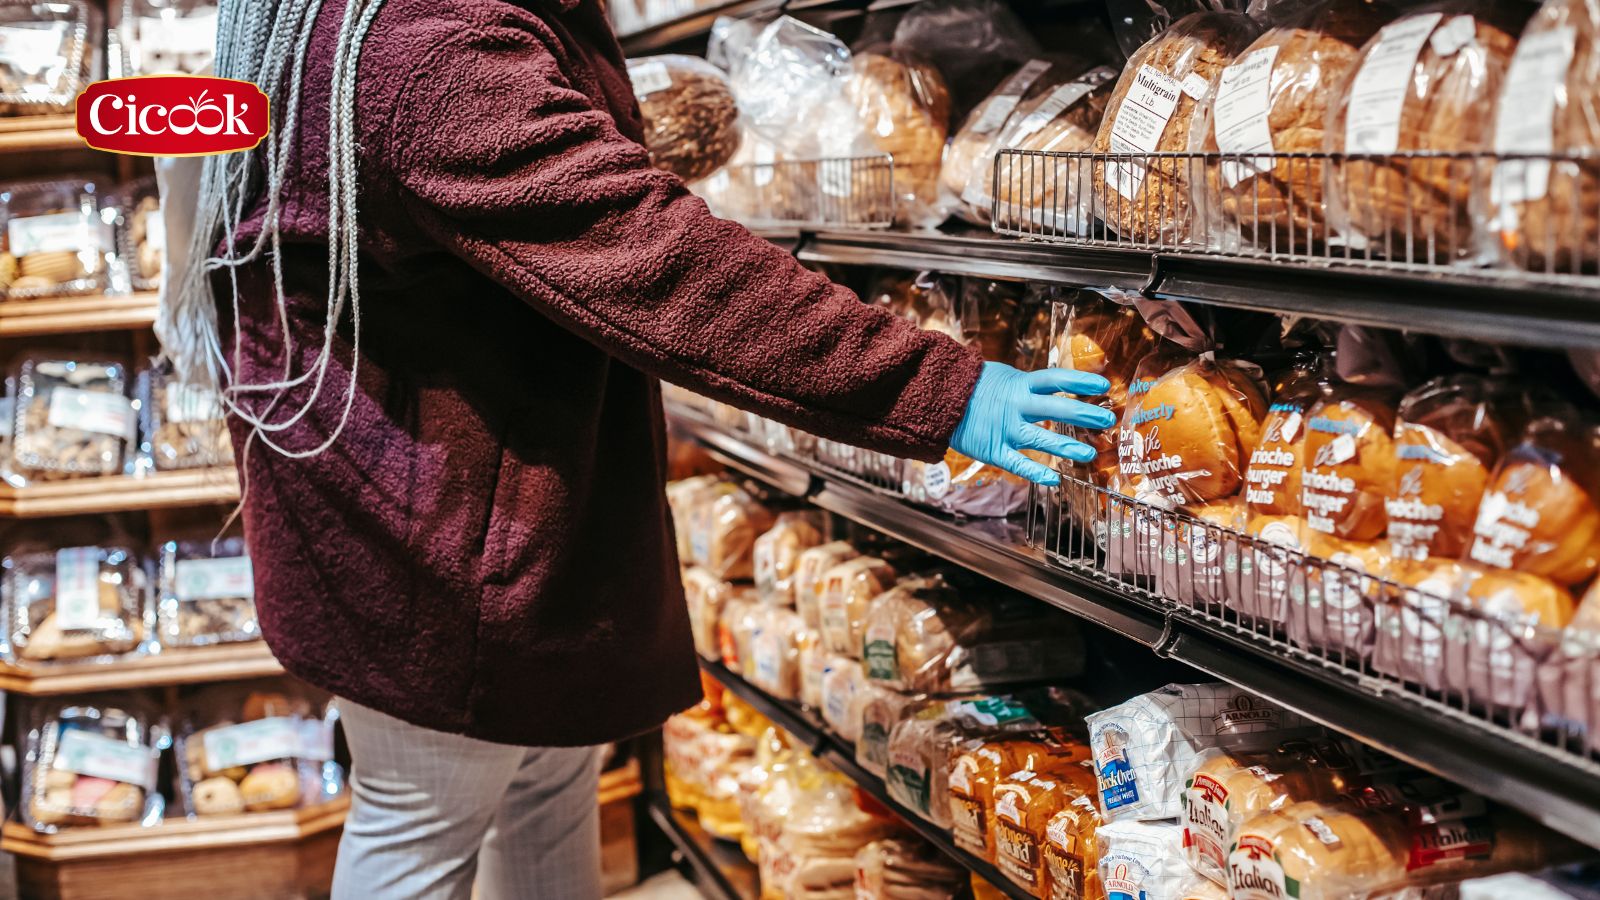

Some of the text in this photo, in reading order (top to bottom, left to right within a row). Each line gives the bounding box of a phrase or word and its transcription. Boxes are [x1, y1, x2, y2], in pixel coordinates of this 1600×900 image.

[1137, 73, 1176, 102] Multigrain
[1154, 69, 1176, 87] NATURAL
[1145, 96, 1154, 107] Lb
[1131, 402, 1176, 425] akerly
[1145, 425, 1161, 455] the
[1142, 453, 1183, 475] rioche
[1148, 474, 1180, 494] urge
[1225, 711, 1271, 721] ARNOLD
[1108, 880, 1134, 891] ARNOLD
